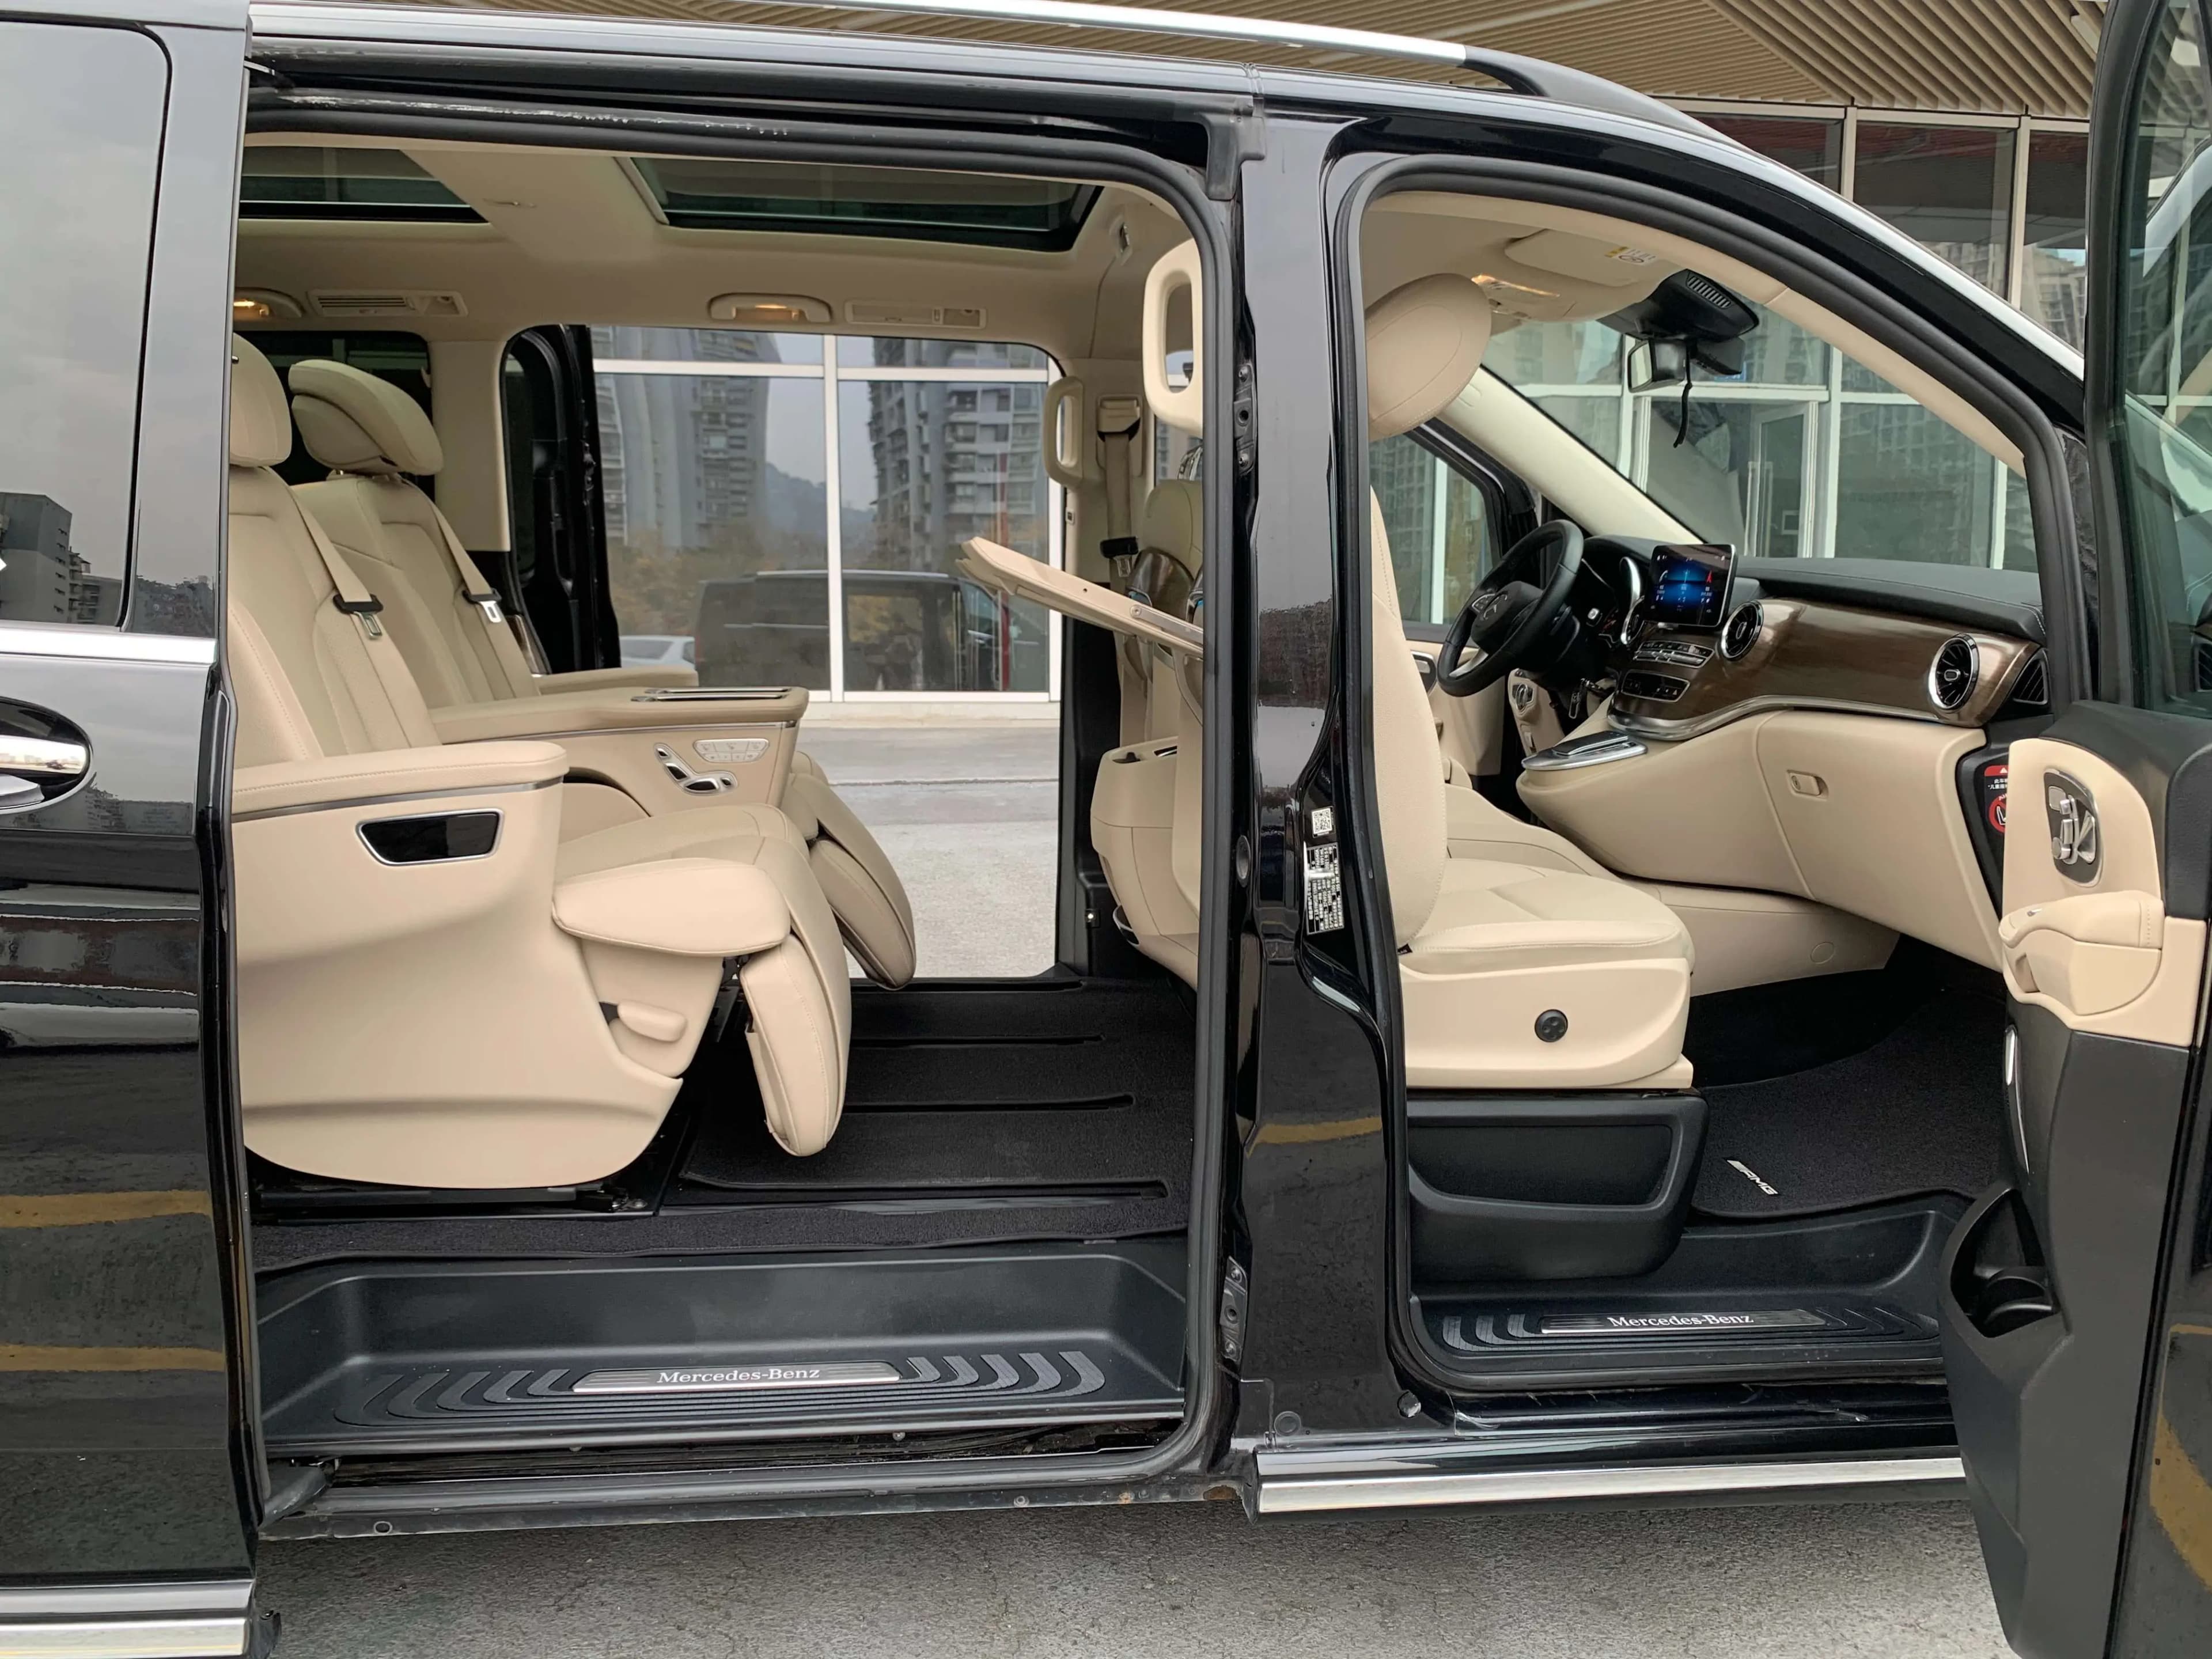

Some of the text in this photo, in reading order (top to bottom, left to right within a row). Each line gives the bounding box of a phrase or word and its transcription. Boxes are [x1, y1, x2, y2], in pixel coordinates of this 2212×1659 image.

[1737, 1164, 1779, 1195] AMG
[1607, 1314, 1755, 1327] Mercedes-Benz
[656, 1368, 821, 1384] Mercedes-Benz
